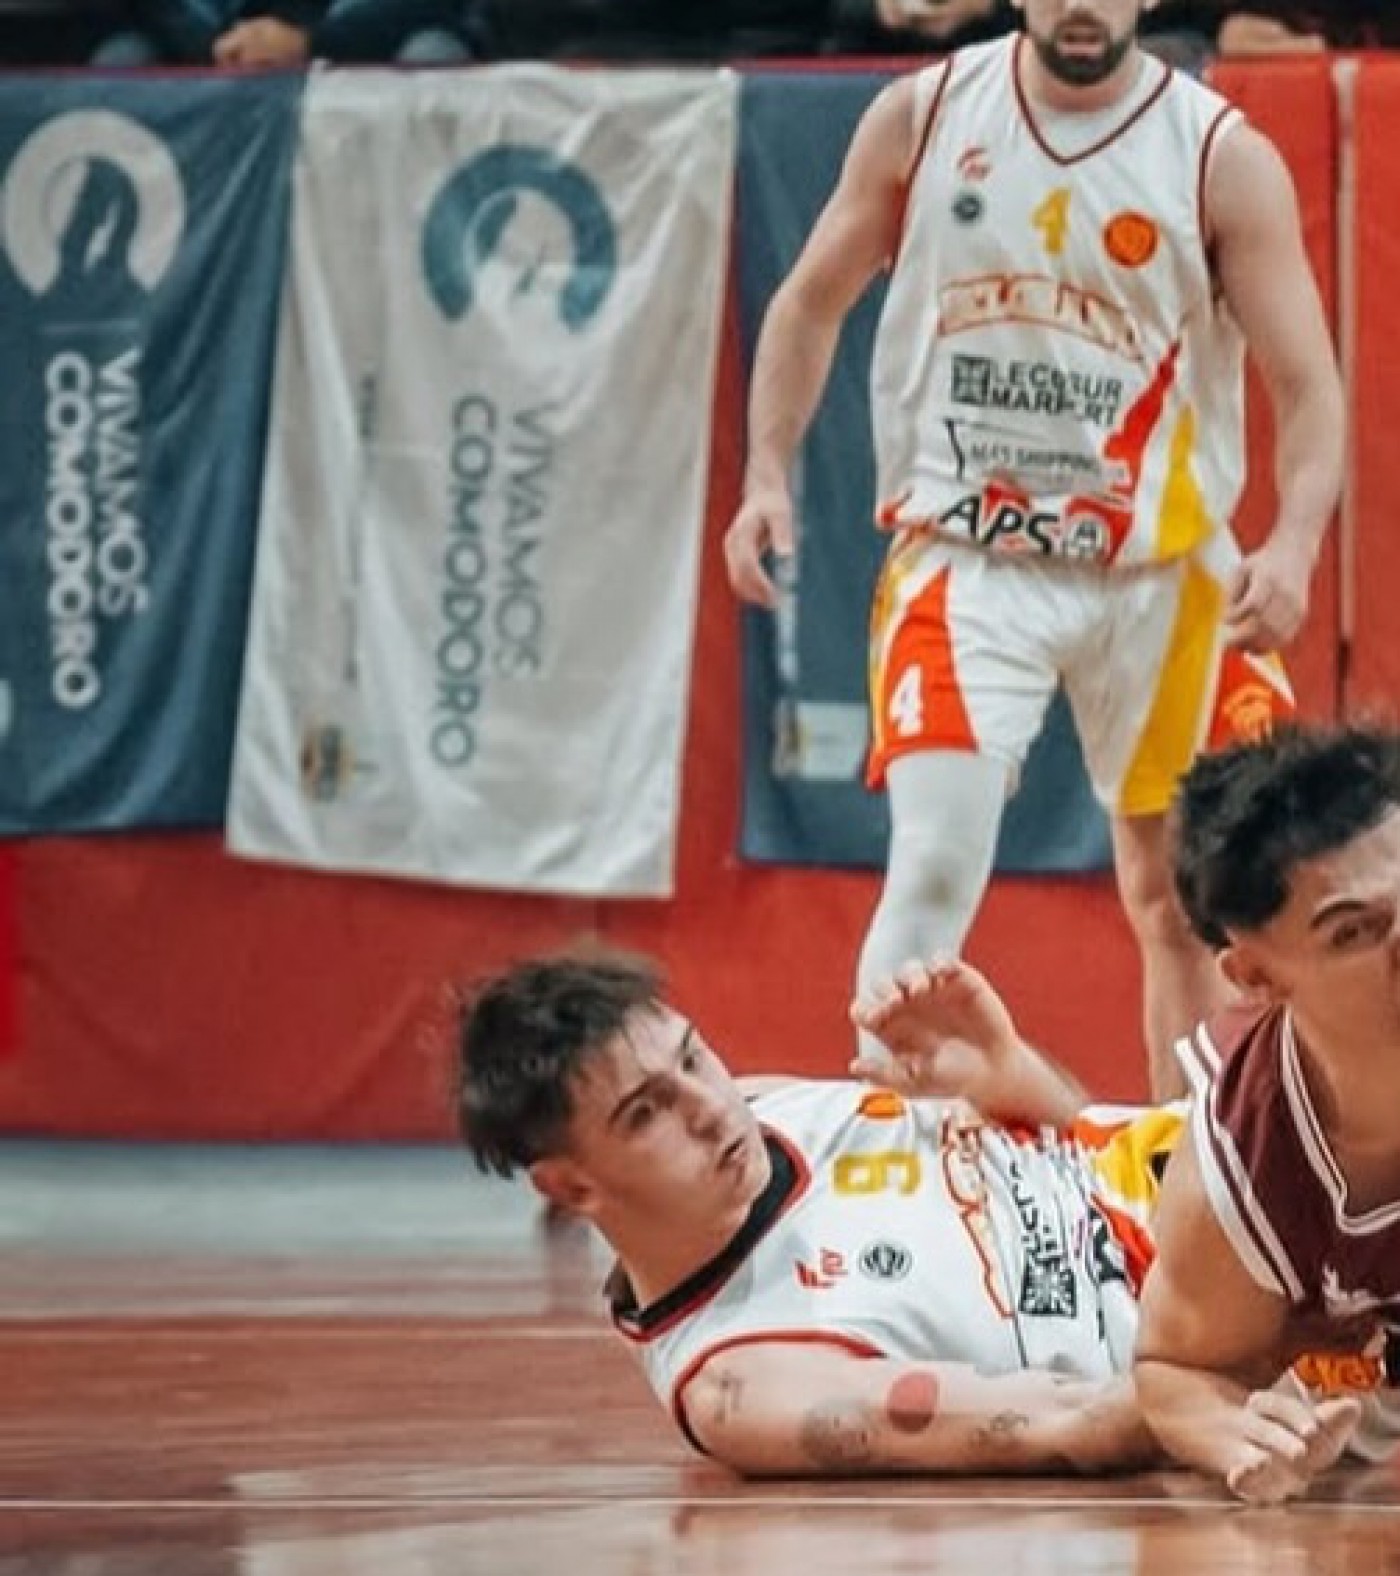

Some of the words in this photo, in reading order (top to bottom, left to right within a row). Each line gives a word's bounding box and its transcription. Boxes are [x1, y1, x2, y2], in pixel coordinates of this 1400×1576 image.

[1031, 187, 1071, 256] 4
[47, 353, 101, 709] COMODORO
[97, 350, 148, 617] VIVAMOS
[431, 394, 496, 768] COMODORO
[495, 403, 562, 678] VIVAMOS
[939, 495, 1059, 553] APS
[889, 664, 924, 736] 4
